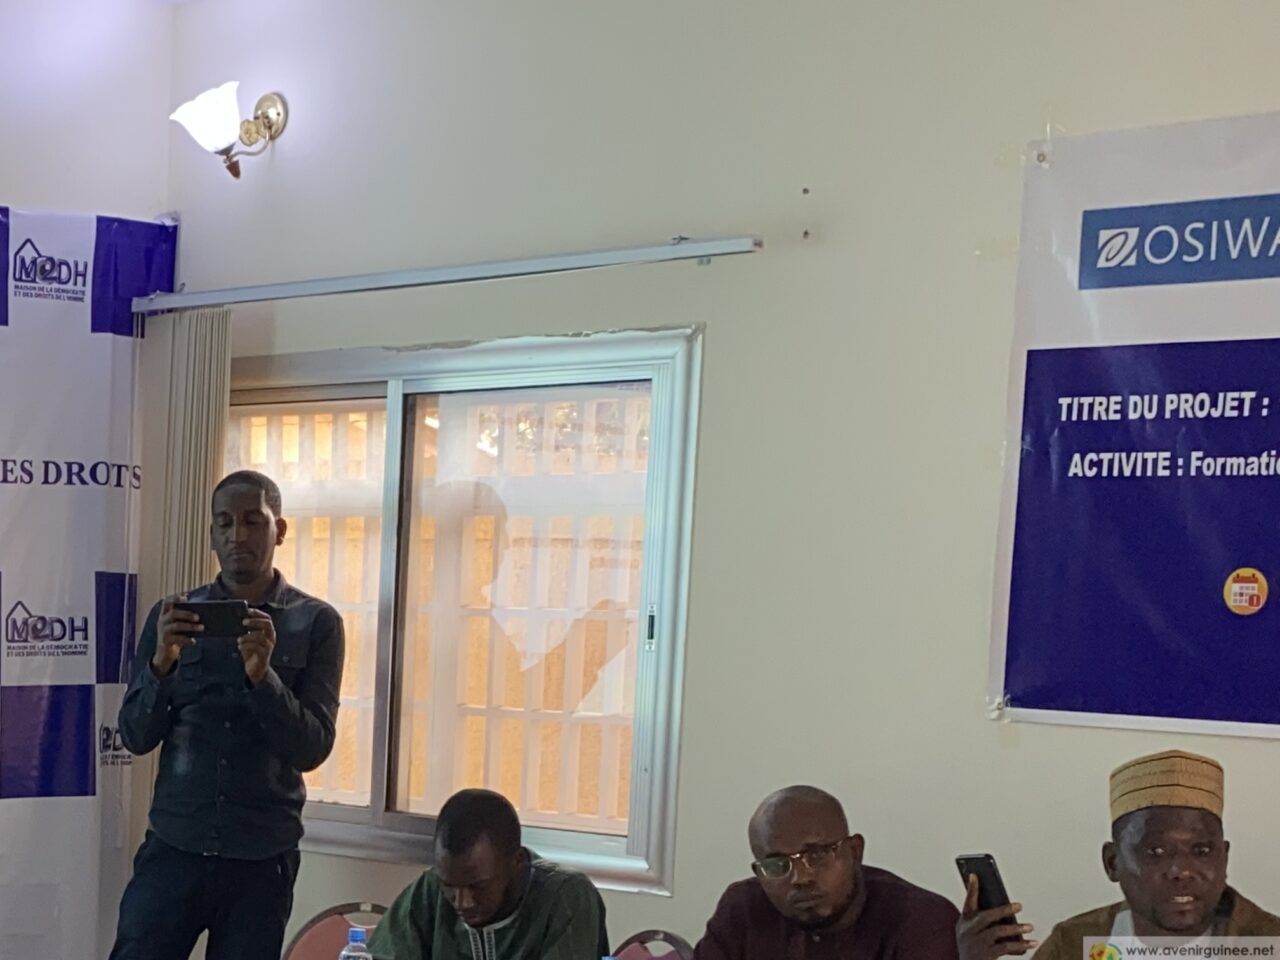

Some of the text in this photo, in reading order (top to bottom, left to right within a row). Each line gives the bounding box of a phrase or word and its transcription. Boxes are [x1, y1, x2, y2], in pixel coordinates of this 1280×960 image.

[1058, 395, 1122, 421] TITRE
[1128, 394, 1158, 420] DU
[1164, 391, 1257, 420] PROJET
[1068, 451, 1171, 477] ACTIVITE
